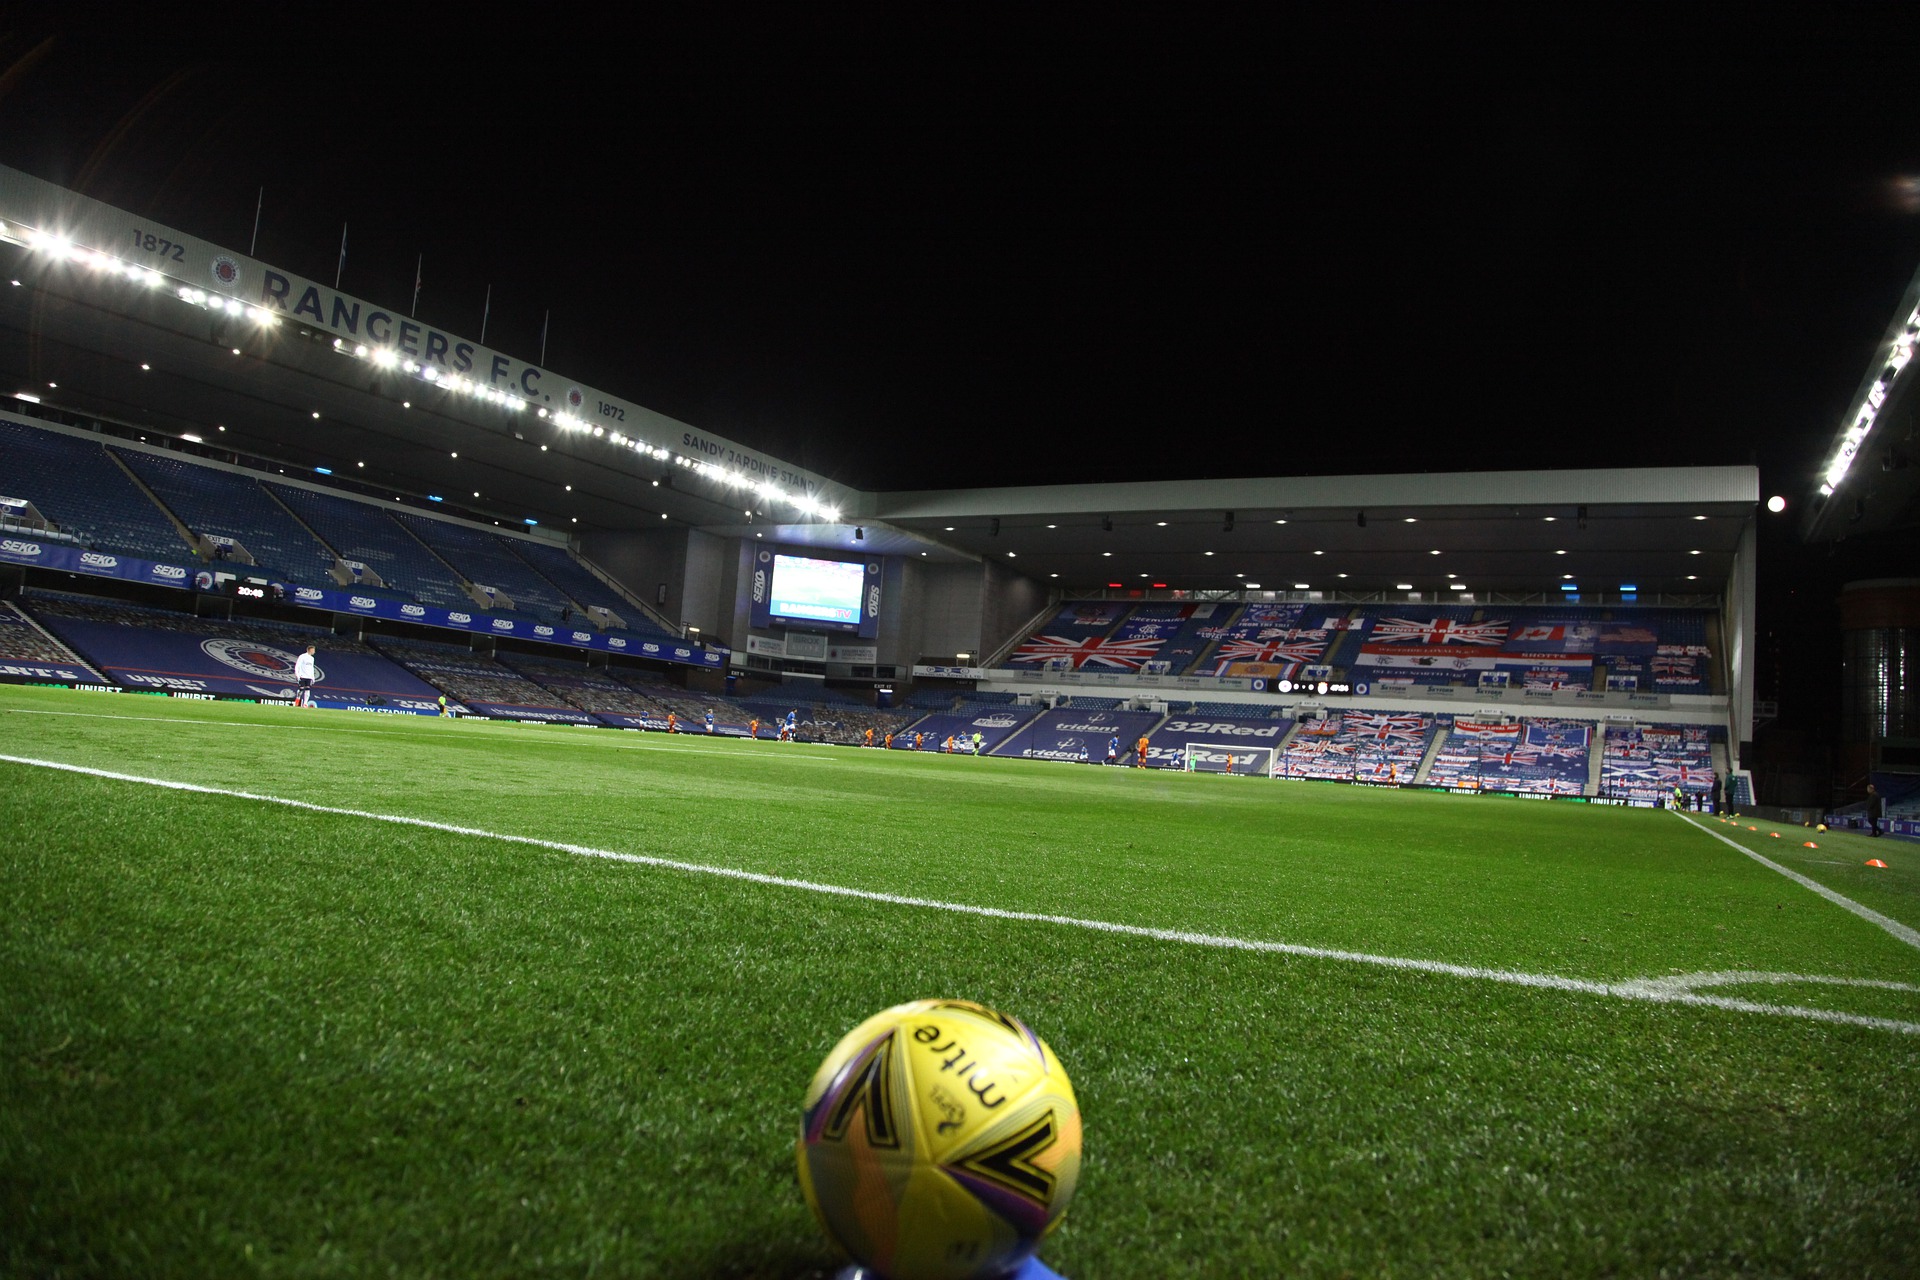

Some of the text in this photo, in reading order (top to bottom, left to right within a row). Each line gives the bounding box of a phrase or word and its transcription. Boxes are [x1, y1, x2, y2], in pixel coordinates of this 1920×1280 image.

[133, 229, 184, 263] 1872
[261, 270, 551, 402] RANGERS F.C.
[598, 401, 626, 422] 1872
[683, 433, 815, 491] SANDY JARDINE STAND
[1, 540, 41, 555] SEKO
[80, 553, 117, 567] SEKO
[152, 565, 187, 579] SEKO
[753, 570, 765, 604] SEKO
[295, 587, 323, 600] SEKO
[350, 596, 376, 608] SEKO
[868, 585, 879, 618] SEKO
[401, 604, 425, 616] SEKO
[836, 609, 851, 618] TV
[448, 612, 471, 623] SEKO
[492, 619, 514, 630] SEKO
[534, 625, 554, 636] SEKO
[75, 684, 123, 693] UNIBET
[172, 692, 216, 700] UNIBET
[377, 708, 417, 716] STADIUM
[1055, 723, 1120, 733] trident
[1165, 721, 1280, 737] 32Red
[1456, 722, 1487, 730] ALLANTON
[1518, 792, 1553, 800] UNIBET
[913, 1024, 1007, 1109] mitre
